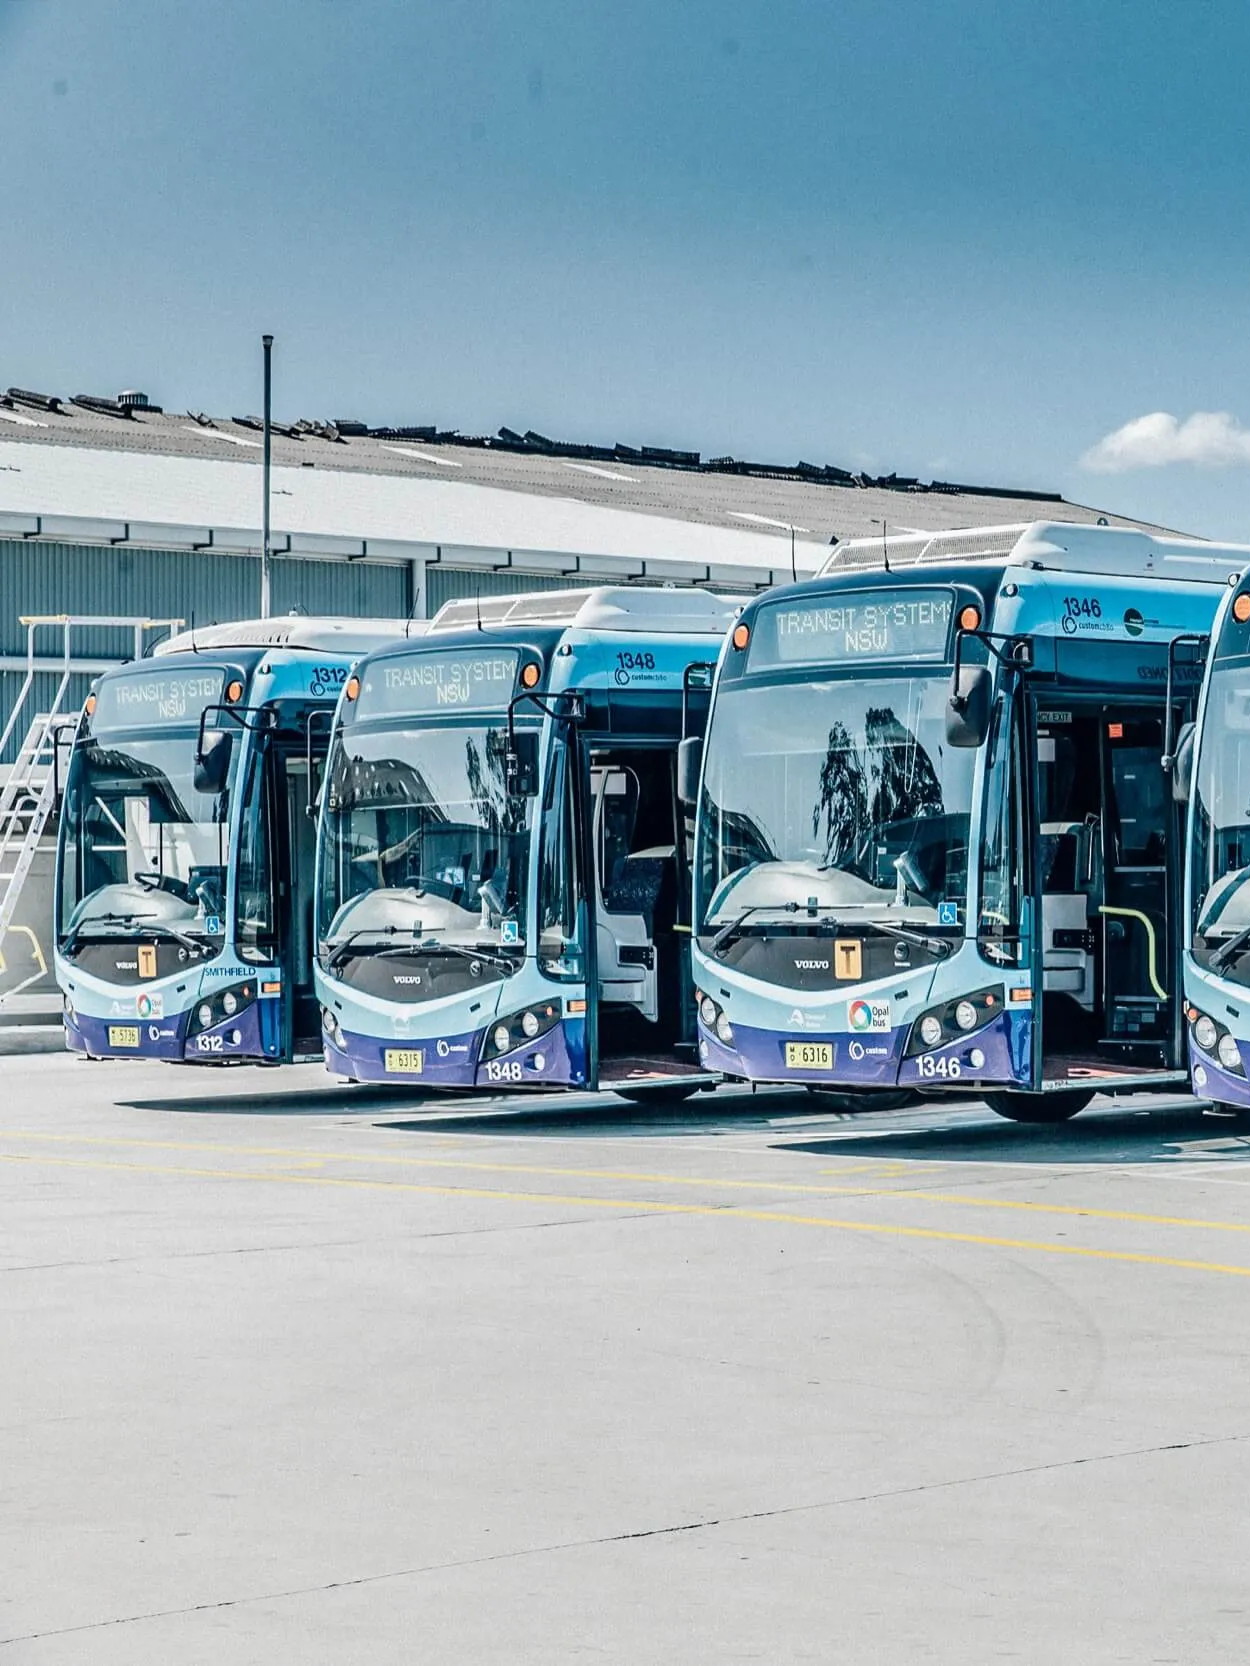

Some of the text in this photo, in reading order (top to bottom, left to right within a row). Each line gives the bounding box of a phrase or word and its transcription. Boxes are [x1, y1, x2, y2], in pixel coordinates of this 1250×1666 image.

[1064, 597, 1101, 617] 1346
[776, 608, 856, 635] TRANSIT
[846, 629, 887, 652] NSW
[617, 652, 655, 669] 1348
[312, 668, 347, 682] 1312
[384, 660, 515, 688] TRANSIT SYSTEM
[116, 680, 165, 704] TRANSIT
[437, 684, 470, 704] NSW
[159, 700, 186, 718] NSW
[142, 951, 152, 974] T
[794, 960, 829, 969] VOLVO
[840, 945, 856, 975] T
[205, 967, 256, 976] SMITHFIELD
[393, 976, 420, 984] VOLVO
[872, 1006, 889, 1020] Opal
[872, 1018, 886, 1027] bus
[196, 1036, 223, 1051] 1312
[399, 1053, 417, 1067] 6315
[802, 1048, 827, 1062] 6316
[485, 1062, 521, 1081] 1348
[915, 1056, 960, 1077] 1346
